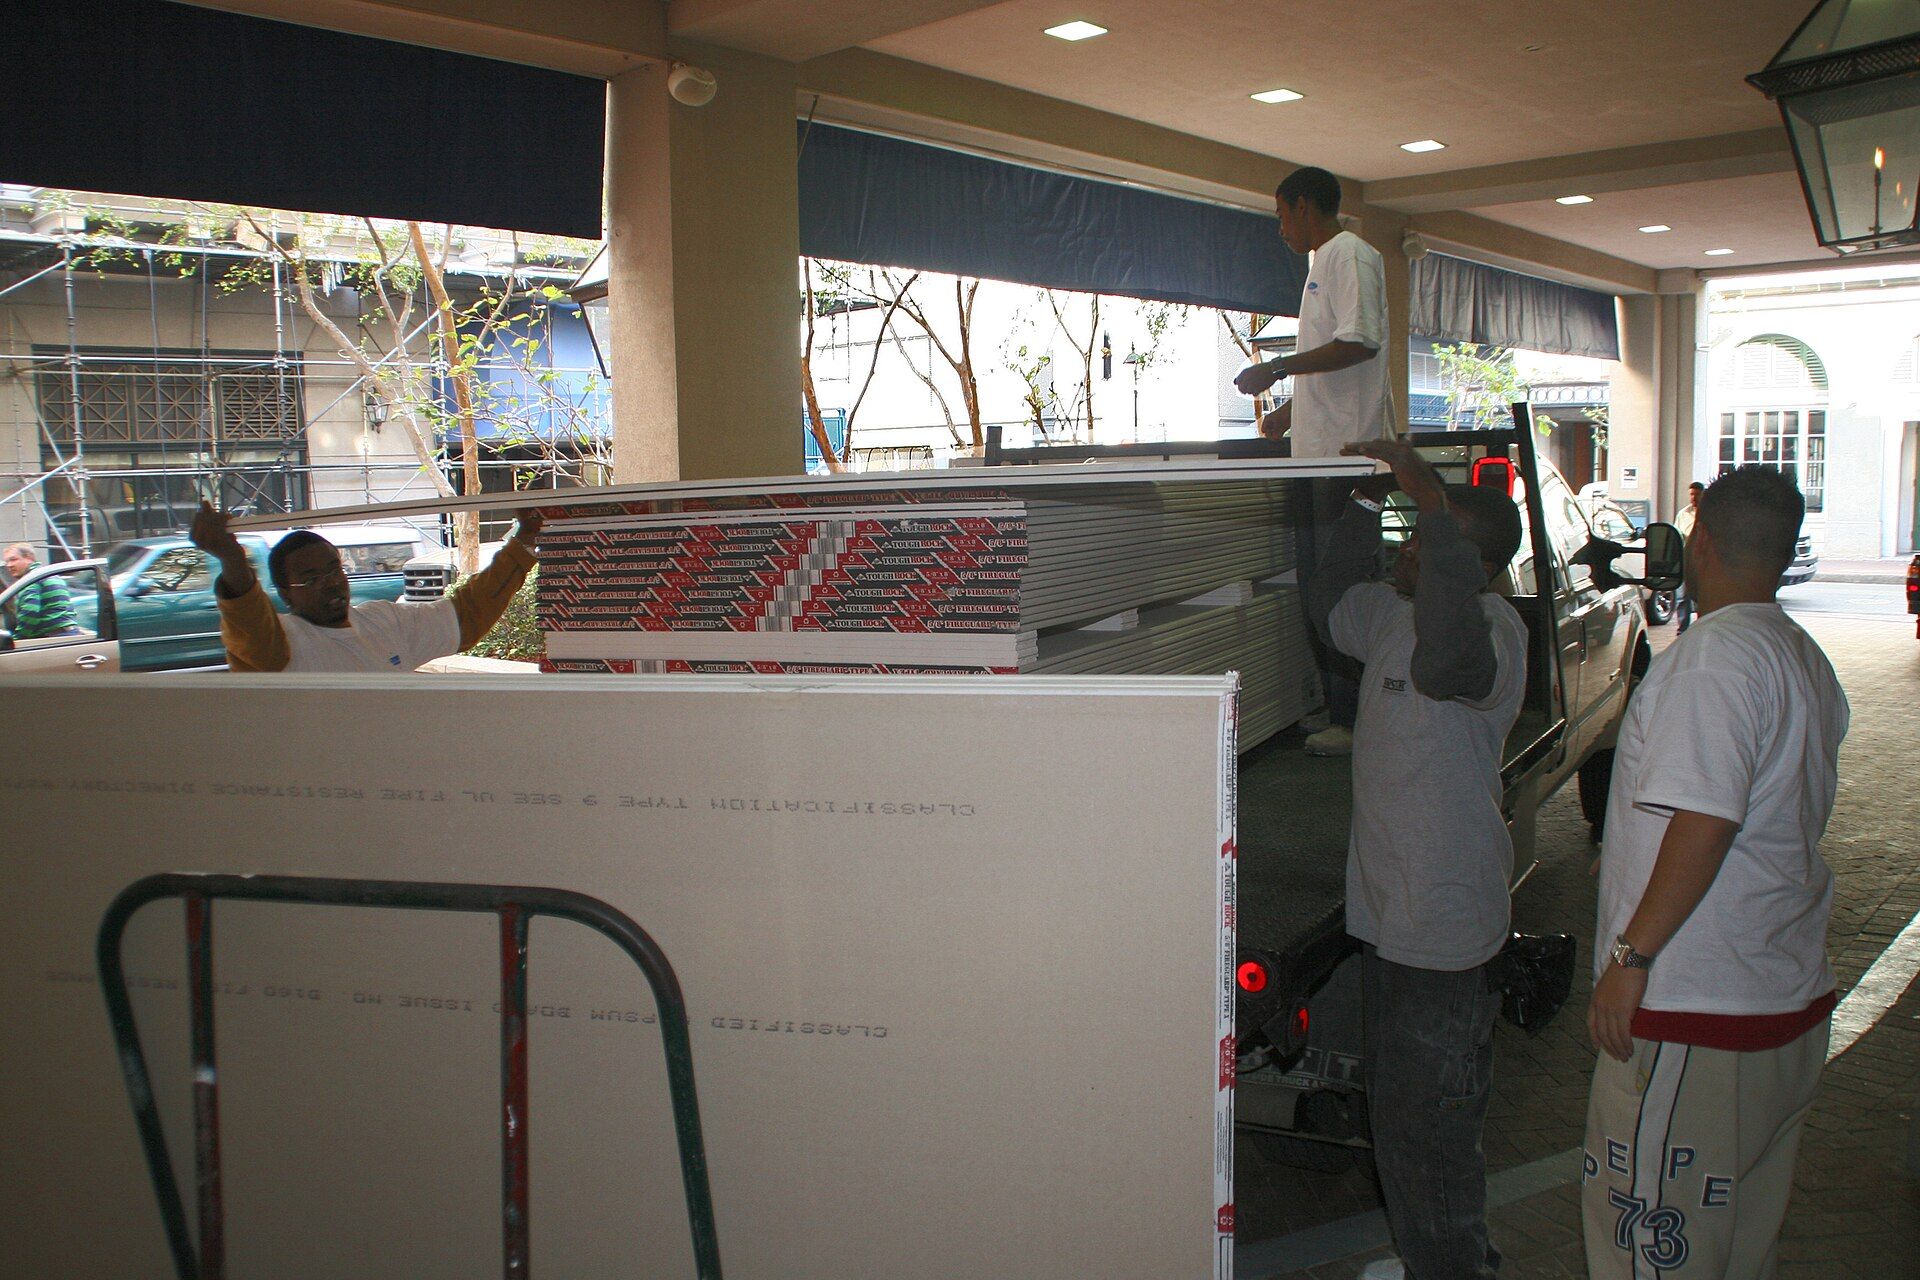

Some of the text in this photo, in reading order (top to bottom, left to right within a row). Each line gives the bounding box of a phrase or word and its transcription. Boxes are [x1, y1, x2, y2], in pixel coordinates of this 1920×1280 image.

[213, 784, 363, 800] RESISTANCE
[381, 789, 445, 802] FIRE
[463, 792, 495, 803] UL
[512, 793, 562, 805] SEE
[616, 796, 689, 810] TYPE
[711, 797, 977, 817] CLASSIFICATION
[399, 996, 472, 1012] ISSUE
[711, 1016, 887, 1039] CLASSIFIED
[1608, 1186, 1689, 1271] 73
